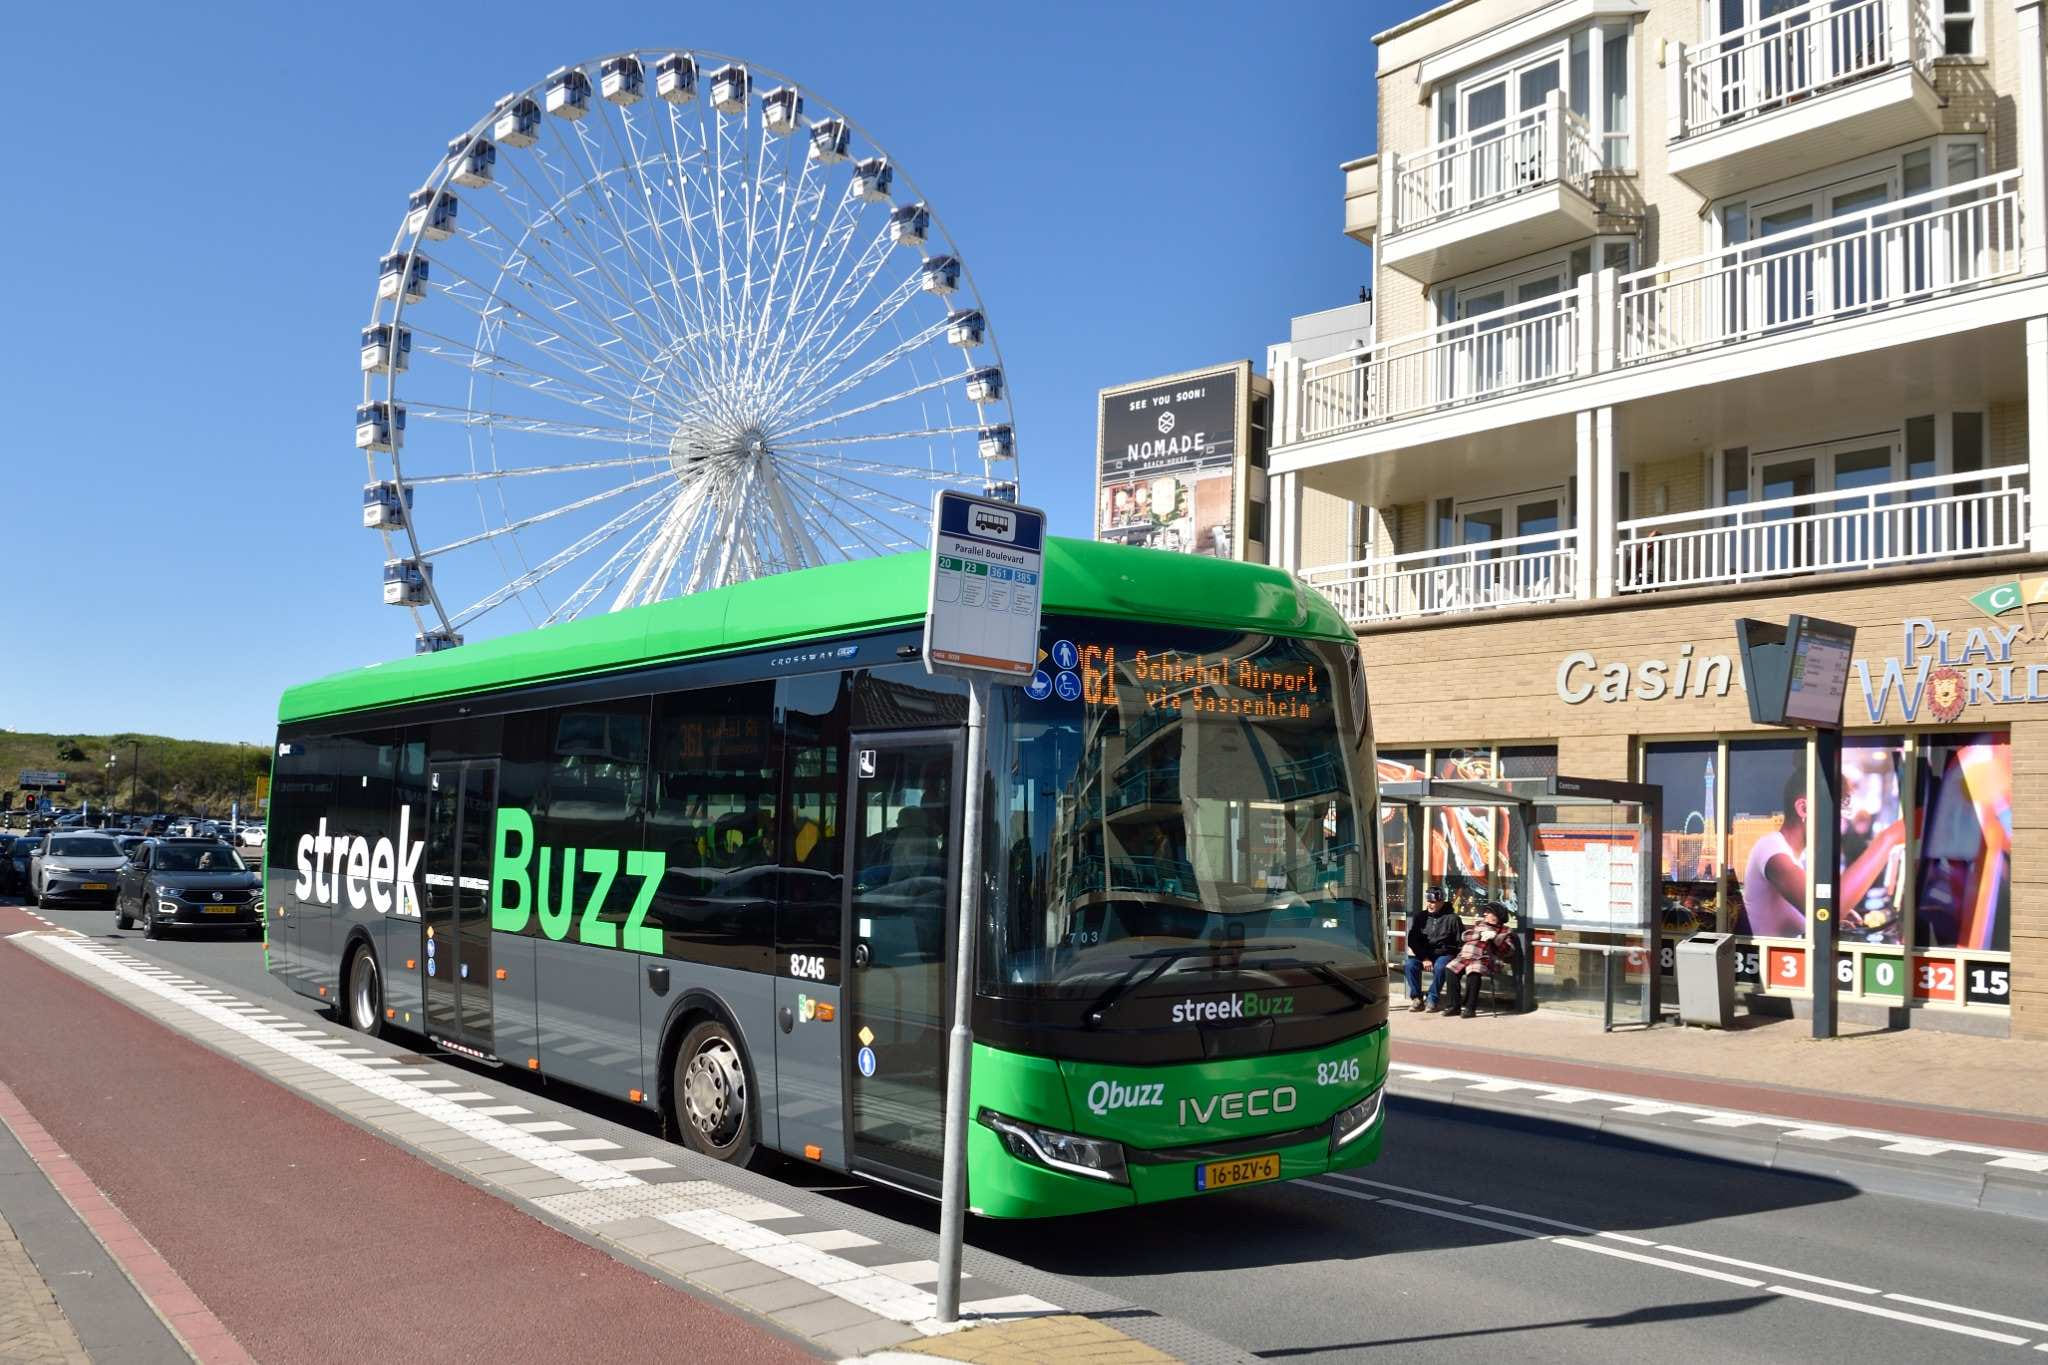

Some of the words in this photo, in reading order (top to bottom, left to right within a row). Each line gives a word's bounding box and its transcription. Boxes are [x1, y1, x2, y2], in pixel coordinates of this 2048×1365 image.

[1129, 400, 1147, 411] SEE
[1152, 394, 1171, 406] YOU
[1176, 387, 1206, 402] SOON!
[1127, 432, 1205, 462] NOMADE
[939, 557, 952, 568] 20
[954, 543, 984, 557] Parallel
[985, 549, 1025, 565] Boulevard
[966, 562, 977, 573] 23
[991, 567, 1007, 579] 361
[1015, 571, 1032, 584] 385
[1903, 616, 2024, 669] PLAY
[770, 651, 833, 666] CROSSWAY
[1078, 644, 1120, 706] 61
[1135, 649, 1230, 686] Schiphol
[1239, 660, 1318, 694] Airport
[1556, 642, 1747, 704] Casin
[1146, 686, 1182, 710] via
[1193, 687, 1310, 720] Sassenheim
[295, 804, 425, 918] streek
[492, 807, 666, 956] Buzz
[1069, 931, 1098, 944] 703
[790, 953, 825, 980] 8246
[1780, 955, 1798, 978] 3
[1875, 962, 1894, 987] 0
[1918, 965, 1954, 991] 32
[1970, 969, 2009, 995] 15
[1172, 992, 1294, 1022] streekBuzz
[1316, 1058, 1360, 1086] 8246
[1087, 1080, 1164, 1116] Qbuzz
[1178, 1085, 1297, 1126] IVECO
[1212, 1159, 1272, 1185] 16-BZV-6
